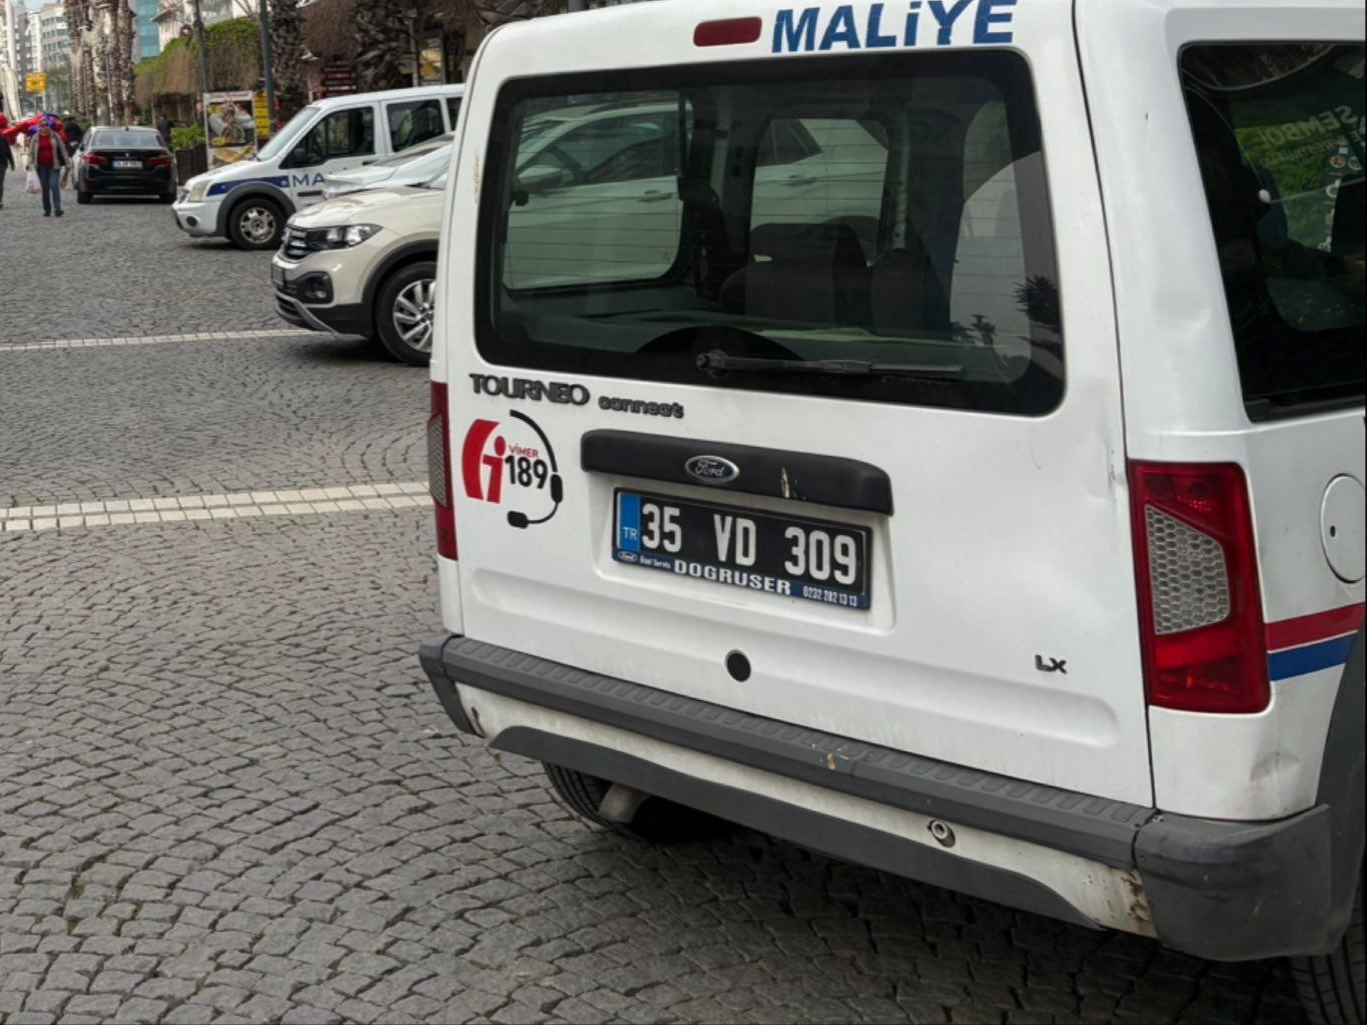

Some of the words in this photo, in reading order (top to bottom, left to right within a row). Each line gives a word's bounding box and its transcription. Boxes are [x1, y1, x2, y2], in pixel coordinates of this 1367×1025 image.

[469, 373, 590, 406] TOURNEO
[597, 395, 685, 419] connect
[504, 455, 548, 490] 189
[694, 460, 725, 478] Ford
[624, 527, 638, 541] TR
[641, 503, 683, 553] 35
[713, 514, 757, 566] VD
[784, 526, 857, 585] 309
[1034, 654, 1068, 675] LX
